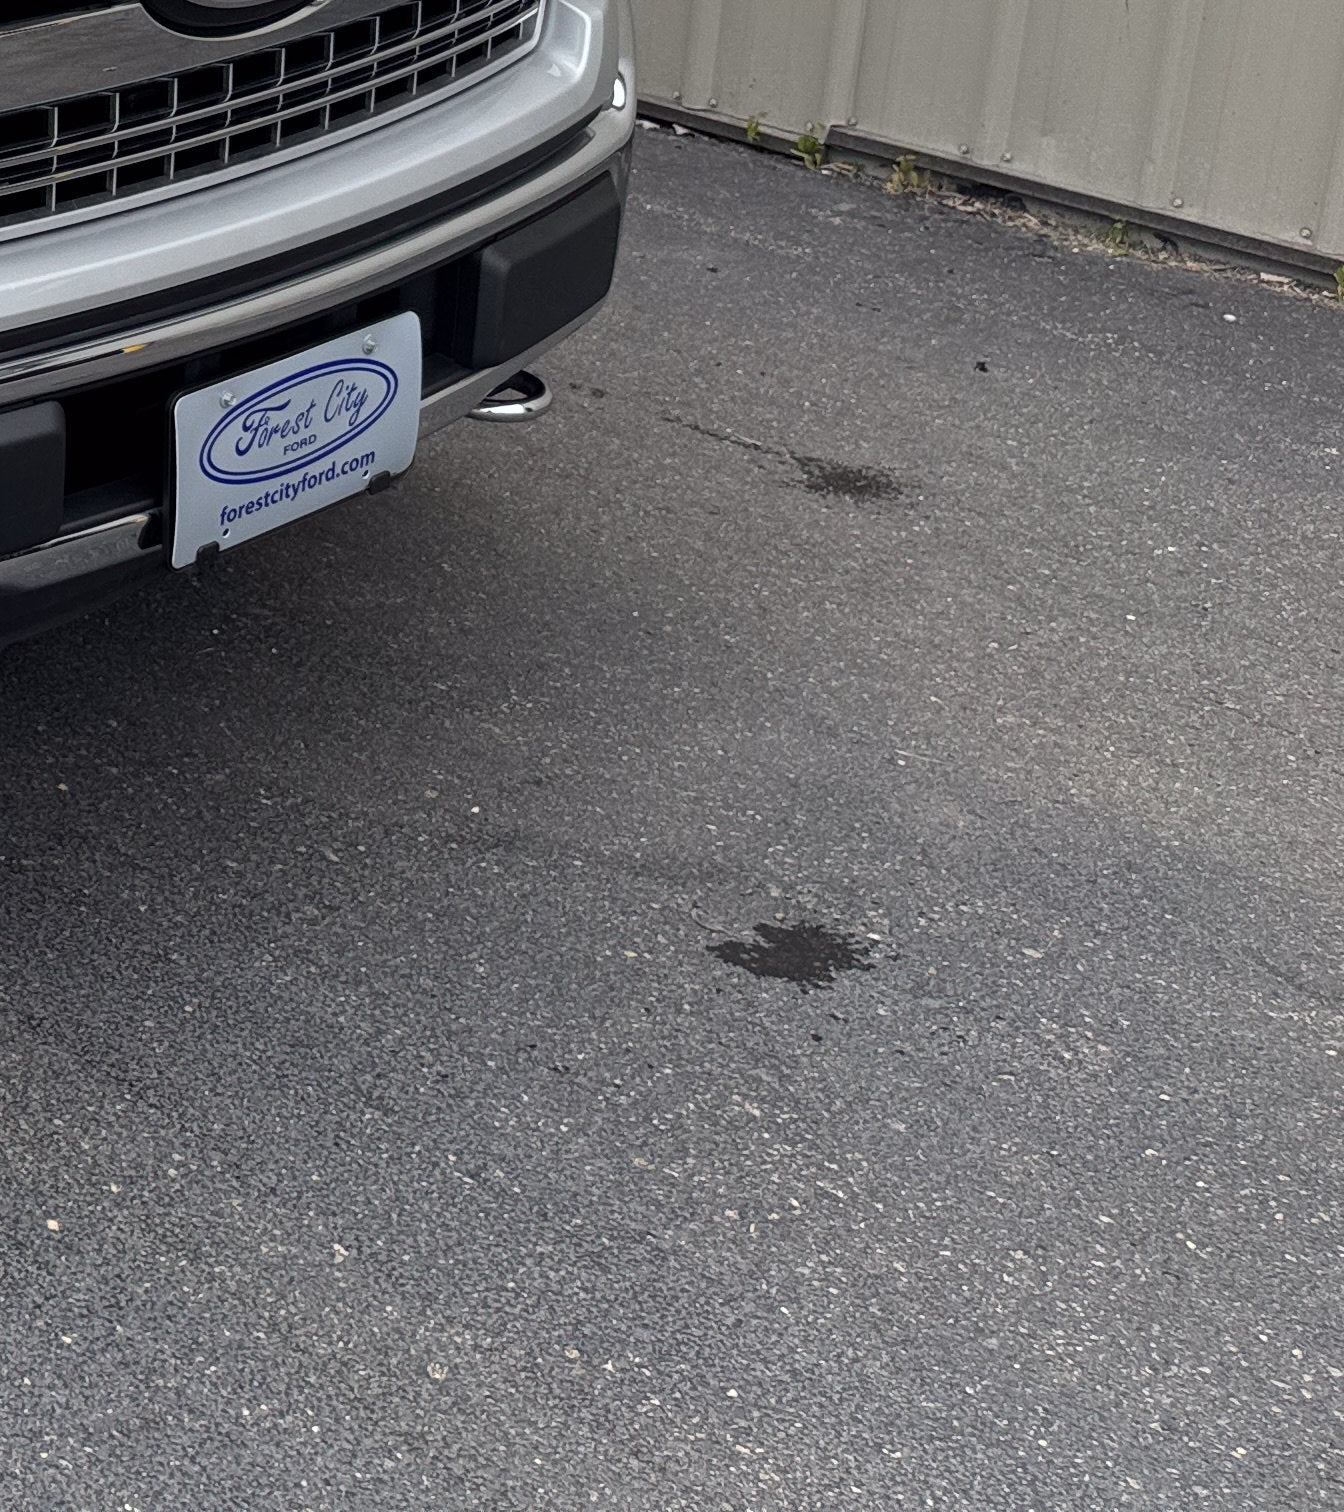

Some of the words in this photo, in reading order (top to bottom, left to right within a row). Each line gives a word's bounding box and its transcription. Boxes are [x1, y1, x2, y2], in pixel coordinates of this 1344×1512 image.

[235, 398, 317, 457] Forest
[323, 379, 370, 427] City
[283, 433, 317, 456] FORD
[219, 450, 376, 526] forestcityford.com
